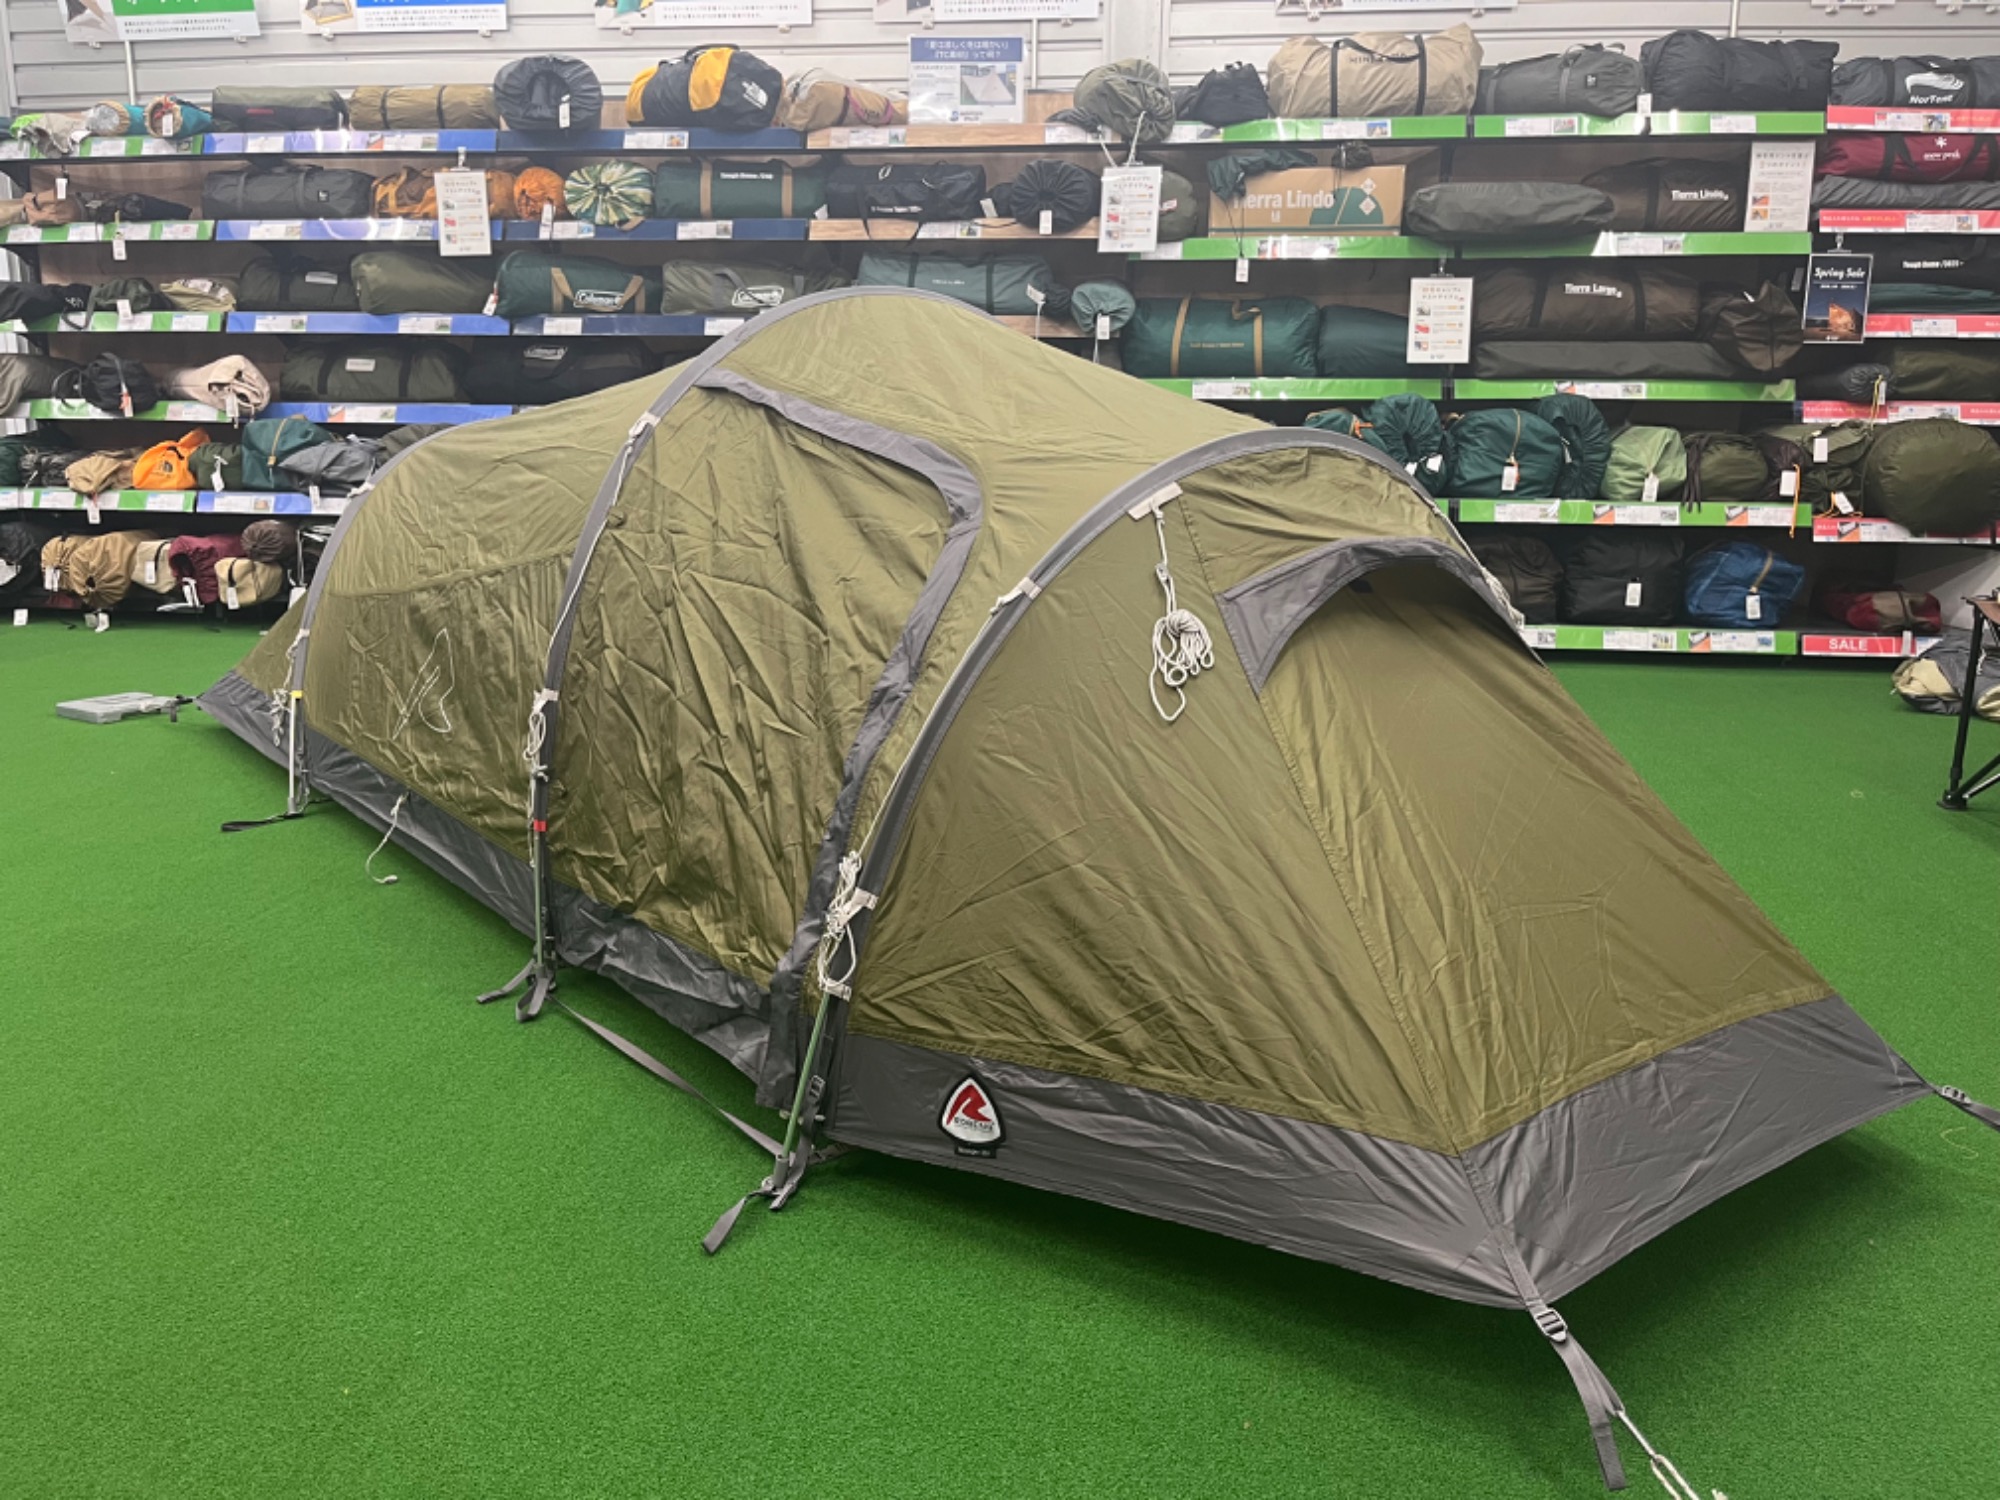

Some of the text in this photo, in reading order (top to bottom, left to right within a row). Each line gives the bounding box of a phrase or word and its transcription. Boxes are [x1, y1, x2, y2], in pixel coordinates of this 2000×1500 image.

[1923, 149, 1960, 161] snow peak
[1233, 190, 1334, 209] erra Lindo
[1672, 189, 1699, 201] Tierra
[1814, 267, 1866, 281] Spring Sale
[1564, 283, 1590, 294] Tierra
[1829, 638, 1868, 652] SALE
